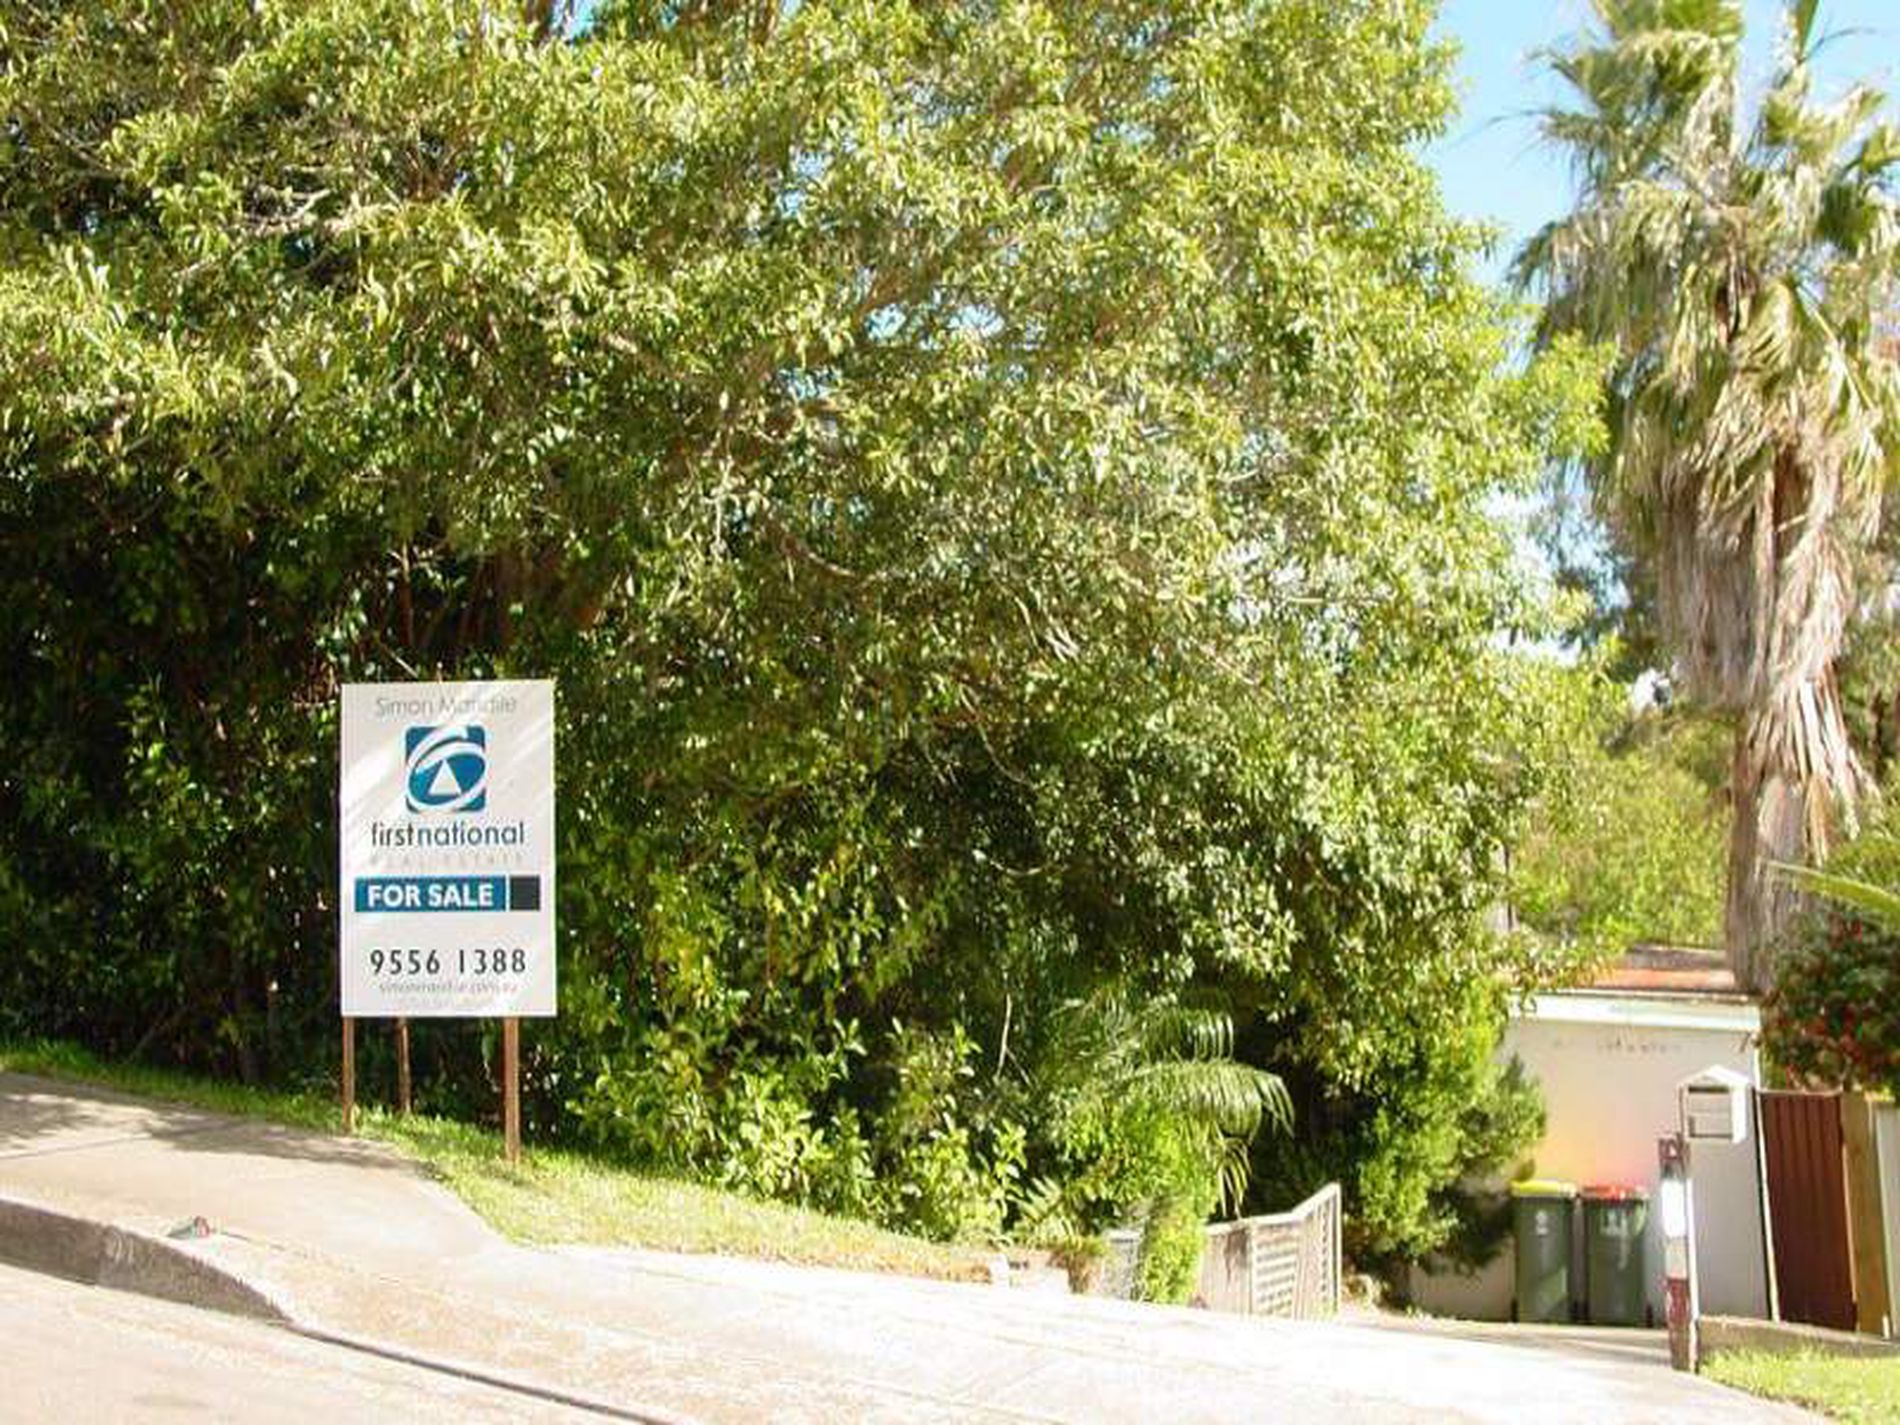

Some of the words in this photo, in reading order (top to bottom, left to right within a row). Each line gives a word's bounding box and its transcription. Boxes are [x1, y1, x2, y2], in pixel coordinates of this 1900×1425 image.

[376, 697, 433, 717] Simon
[368, 884, 421, 908] FOR
[428, 883, 494, 907] SALE
[370, 949, 440, 975] 9556
[459, 948, 526, 975] 1388
